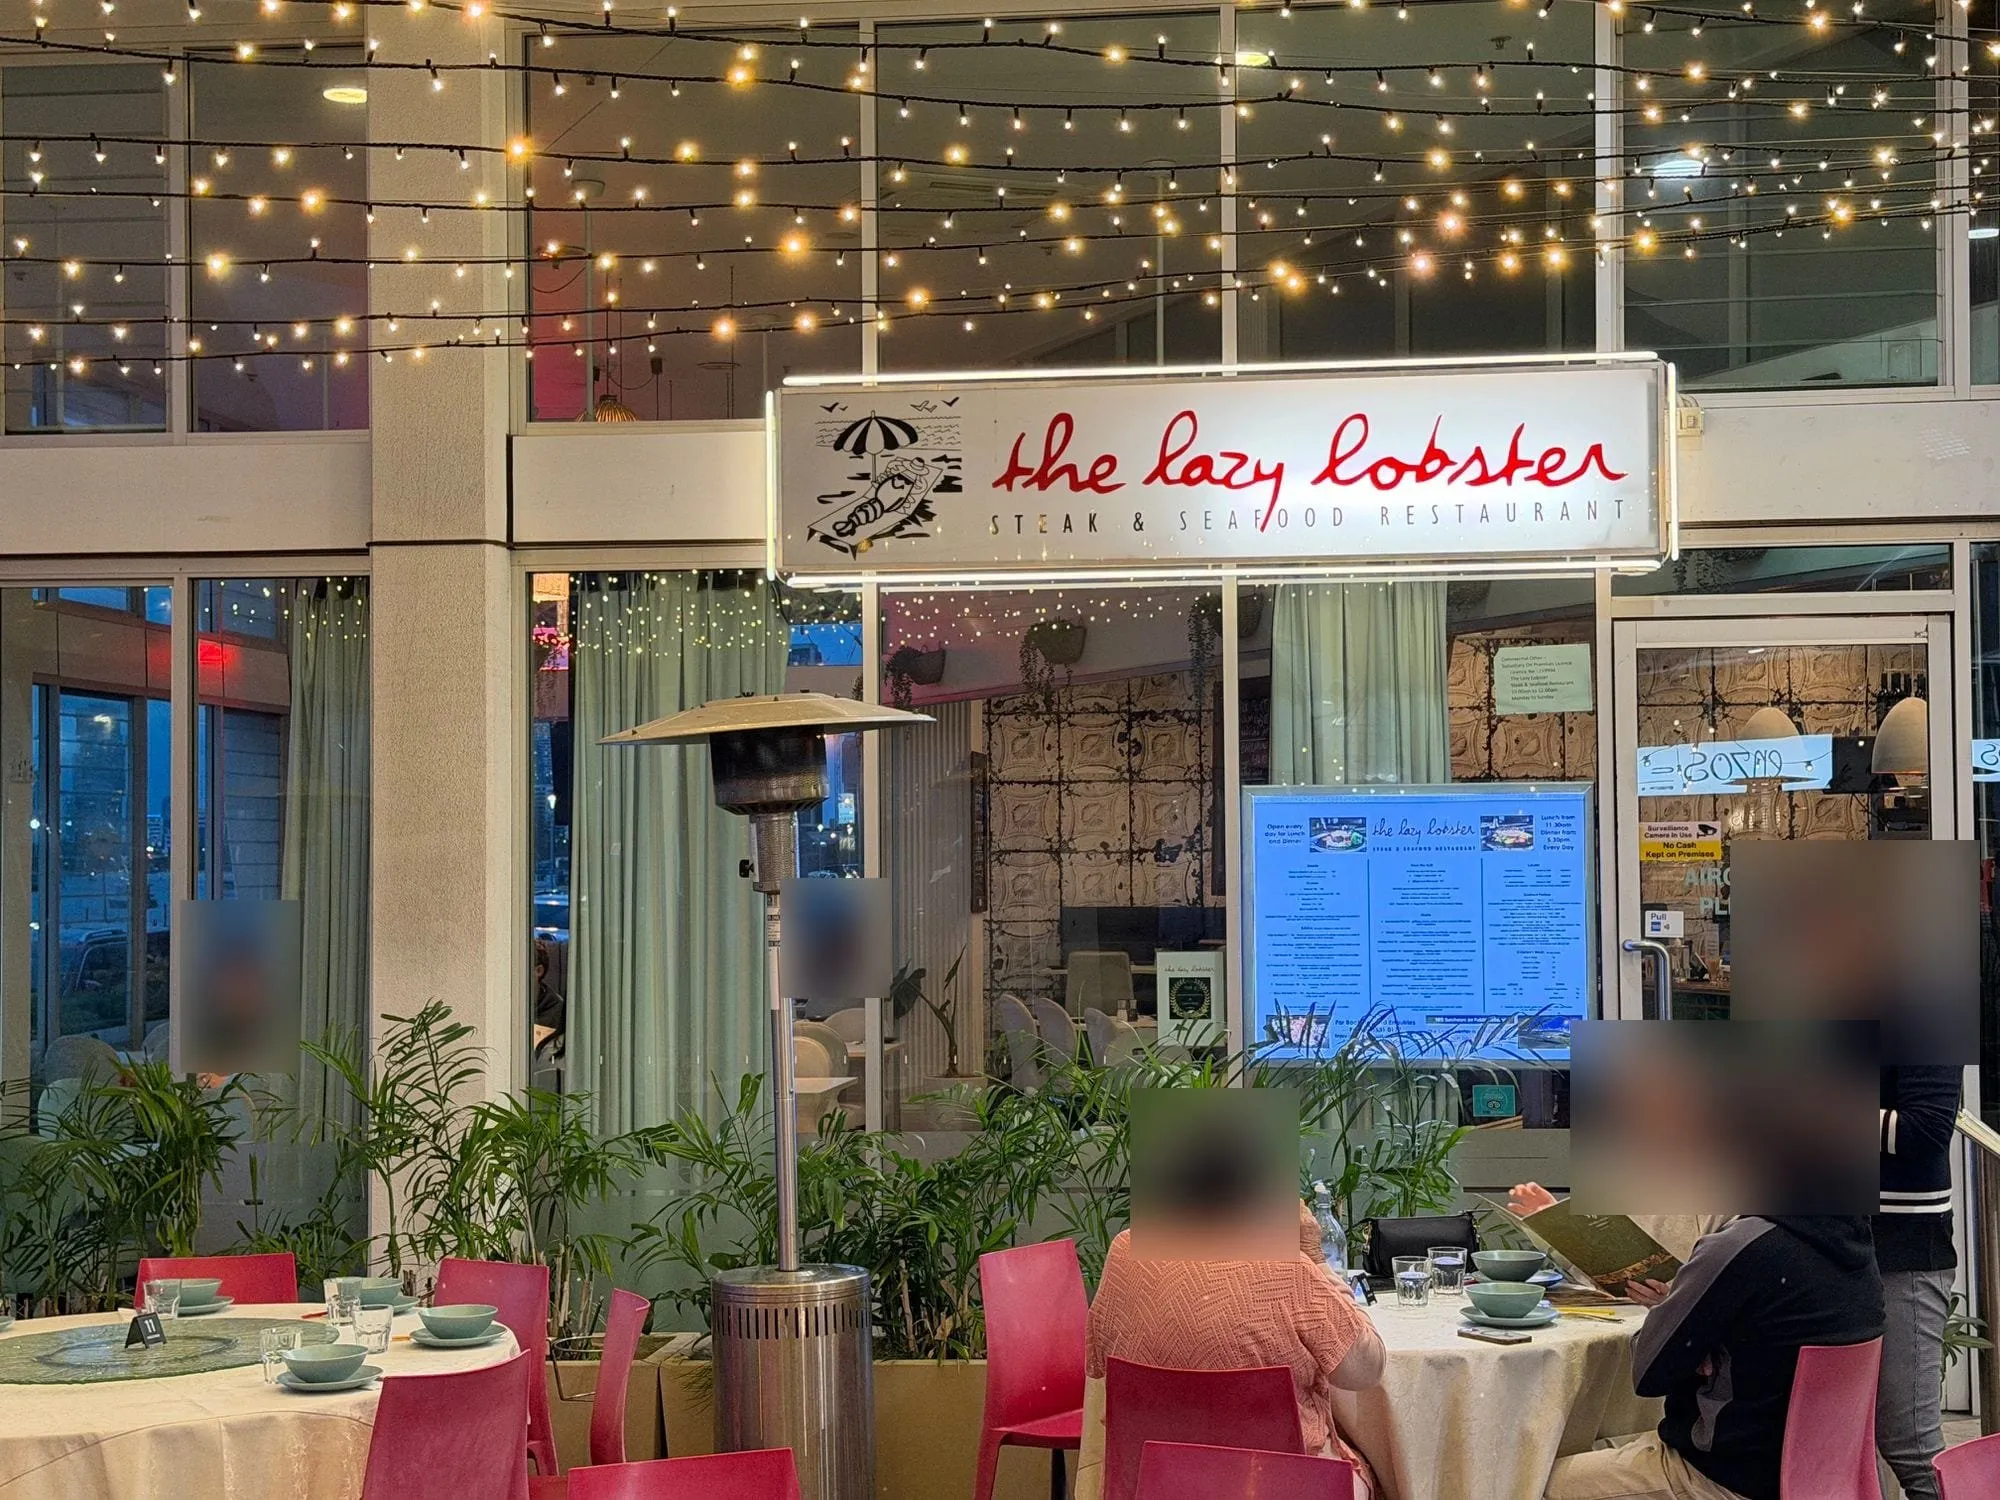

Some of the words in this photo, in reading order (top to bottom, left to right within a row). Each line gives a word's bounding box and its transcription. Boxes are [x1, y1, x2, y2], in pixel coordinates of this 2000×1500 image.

[992, 412, 1127, 494] the
[1142, 410, 1284, 532] lazy
[1311, 413, 1628, 491] lobster
[989, 513, 1097, 535] STEAK
[1133, 511, 1144, 532] &
[1180, 506, 1343, 531] SEAFOOD
[1381, 500, 1624, 526] RESTAURANT
[1372, 818, 1393, 837] the
[1398, 818, 1422, 845] lazy
[1427, 818, 1476, 836] lobster
[1650, 912, 1667, 920] Pull
[144, 1319, 156, 1333] 11
